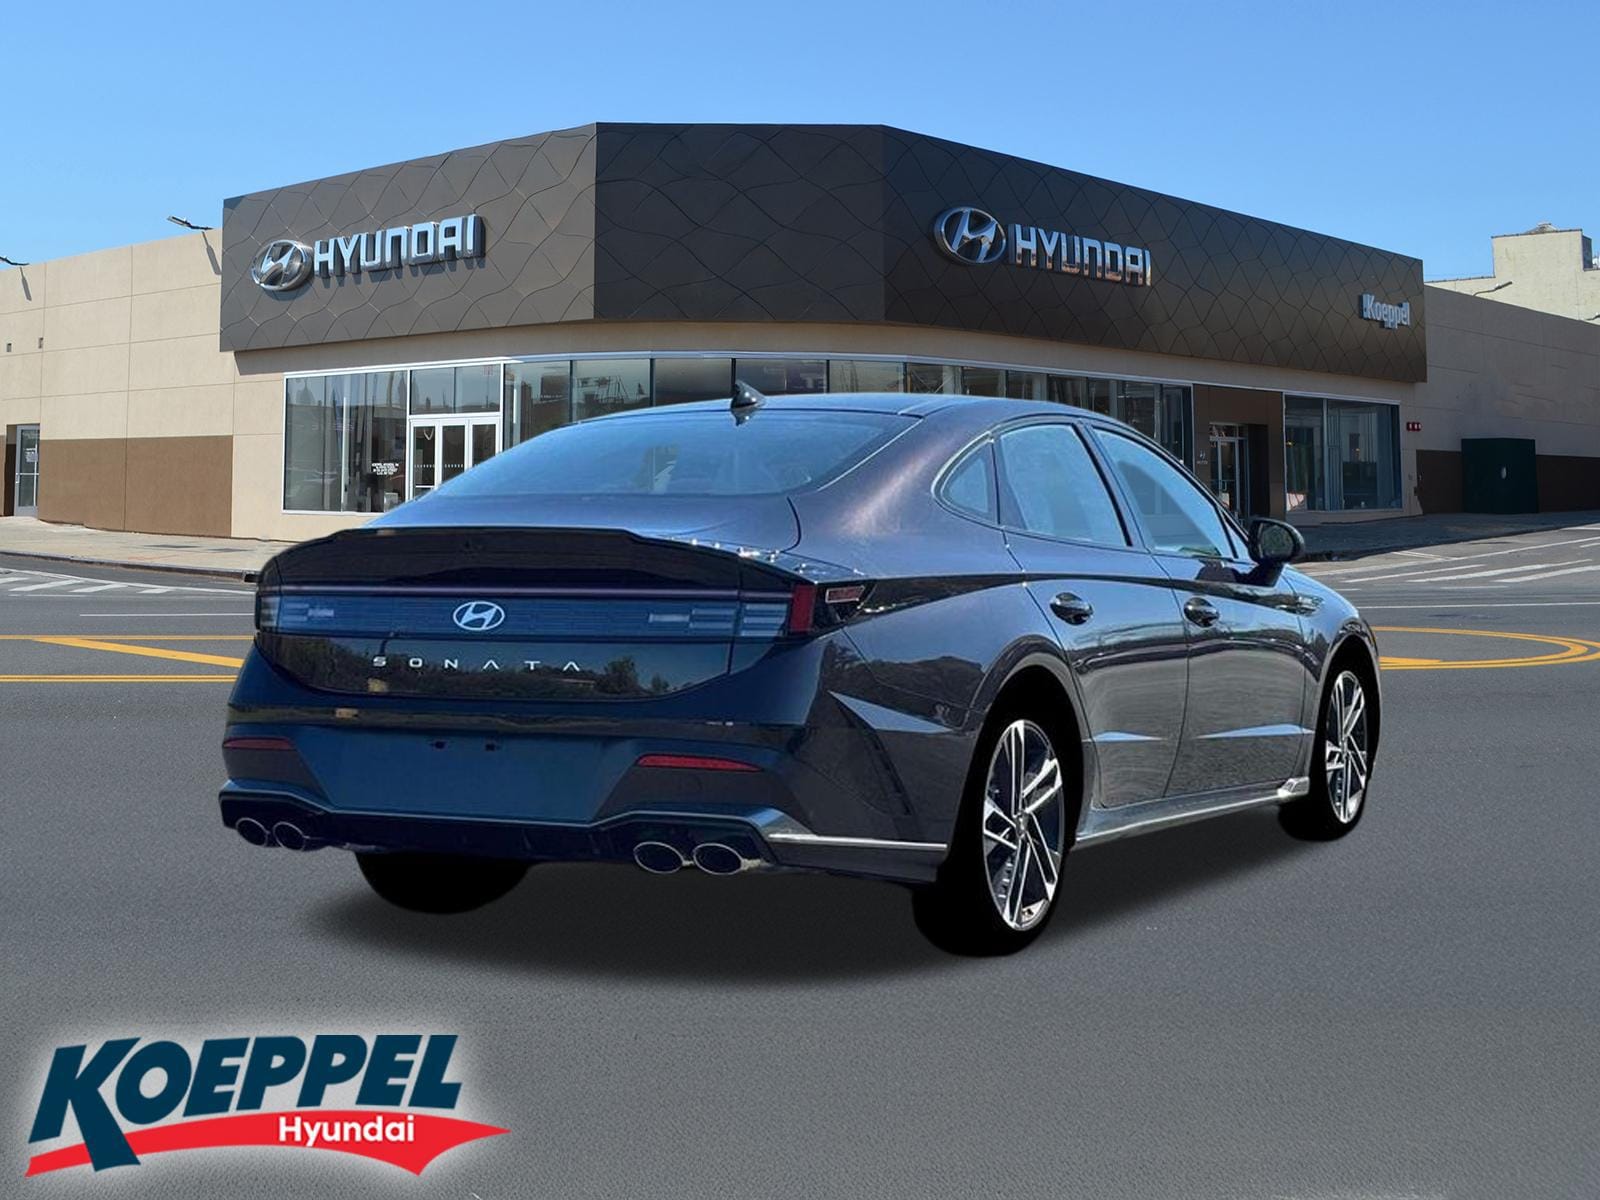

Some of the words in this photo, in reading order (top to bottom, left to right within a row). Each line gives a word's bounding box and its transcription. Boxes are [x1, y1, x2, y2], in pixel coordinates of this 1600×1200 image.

[313, 213, 482, 276] HYUNDAI
[1012, 223, 1152, 287] HYUNDAI
[1362, 293, 1410, 329] Koeppel
[372, 655, 581, 672] SONATA
